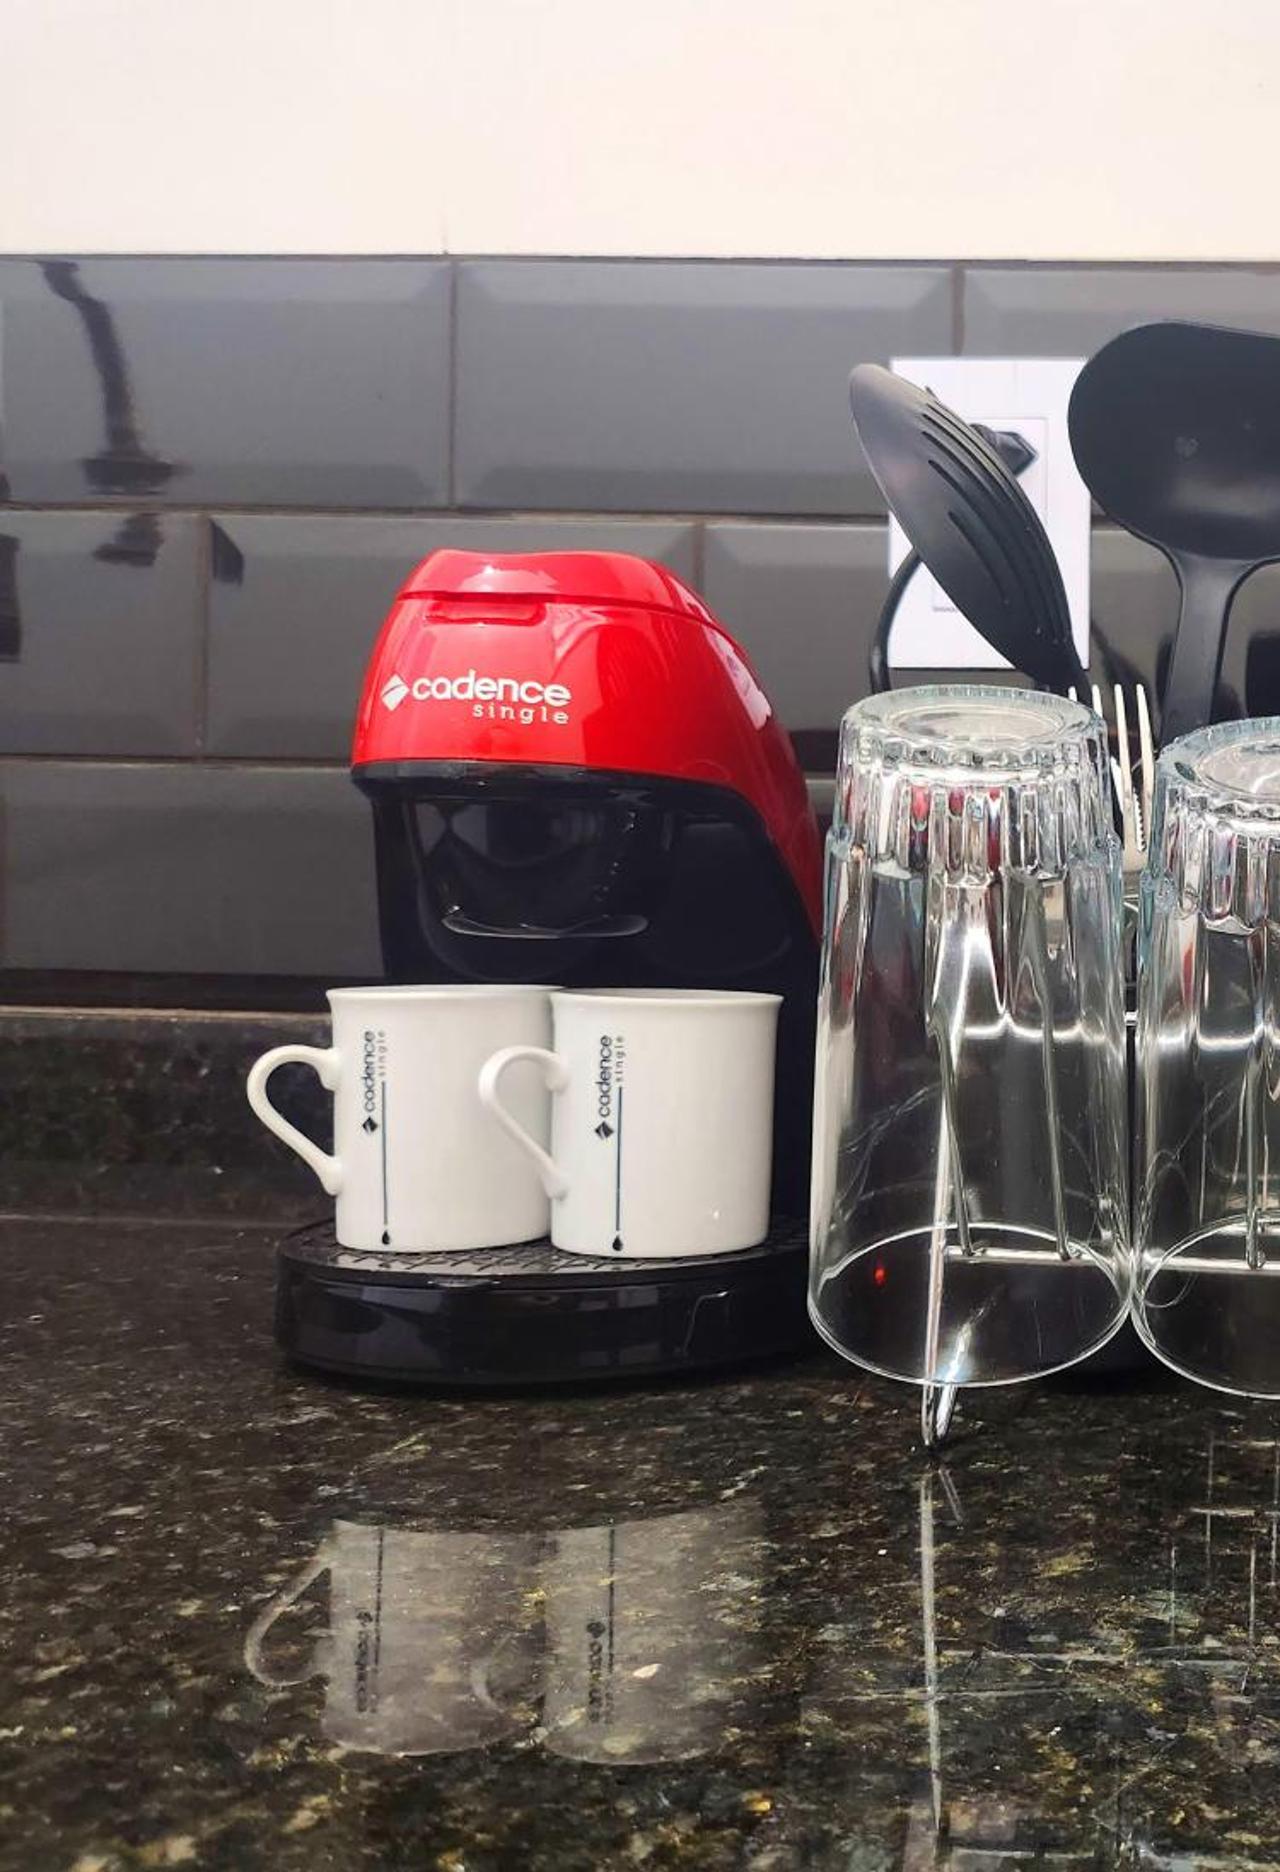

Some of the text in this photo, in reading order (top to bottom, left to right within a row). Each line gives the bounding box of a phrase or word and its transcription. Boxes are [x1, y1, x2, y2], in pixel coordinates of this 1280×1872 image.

[411, 668, 572, 707] cadence
[472, 702, 569, 725] single
[361, 1031, 376, 1112] cadence
[595, 1035, 612, 1118] cadence
[614, 1036, 626, 1083] single
